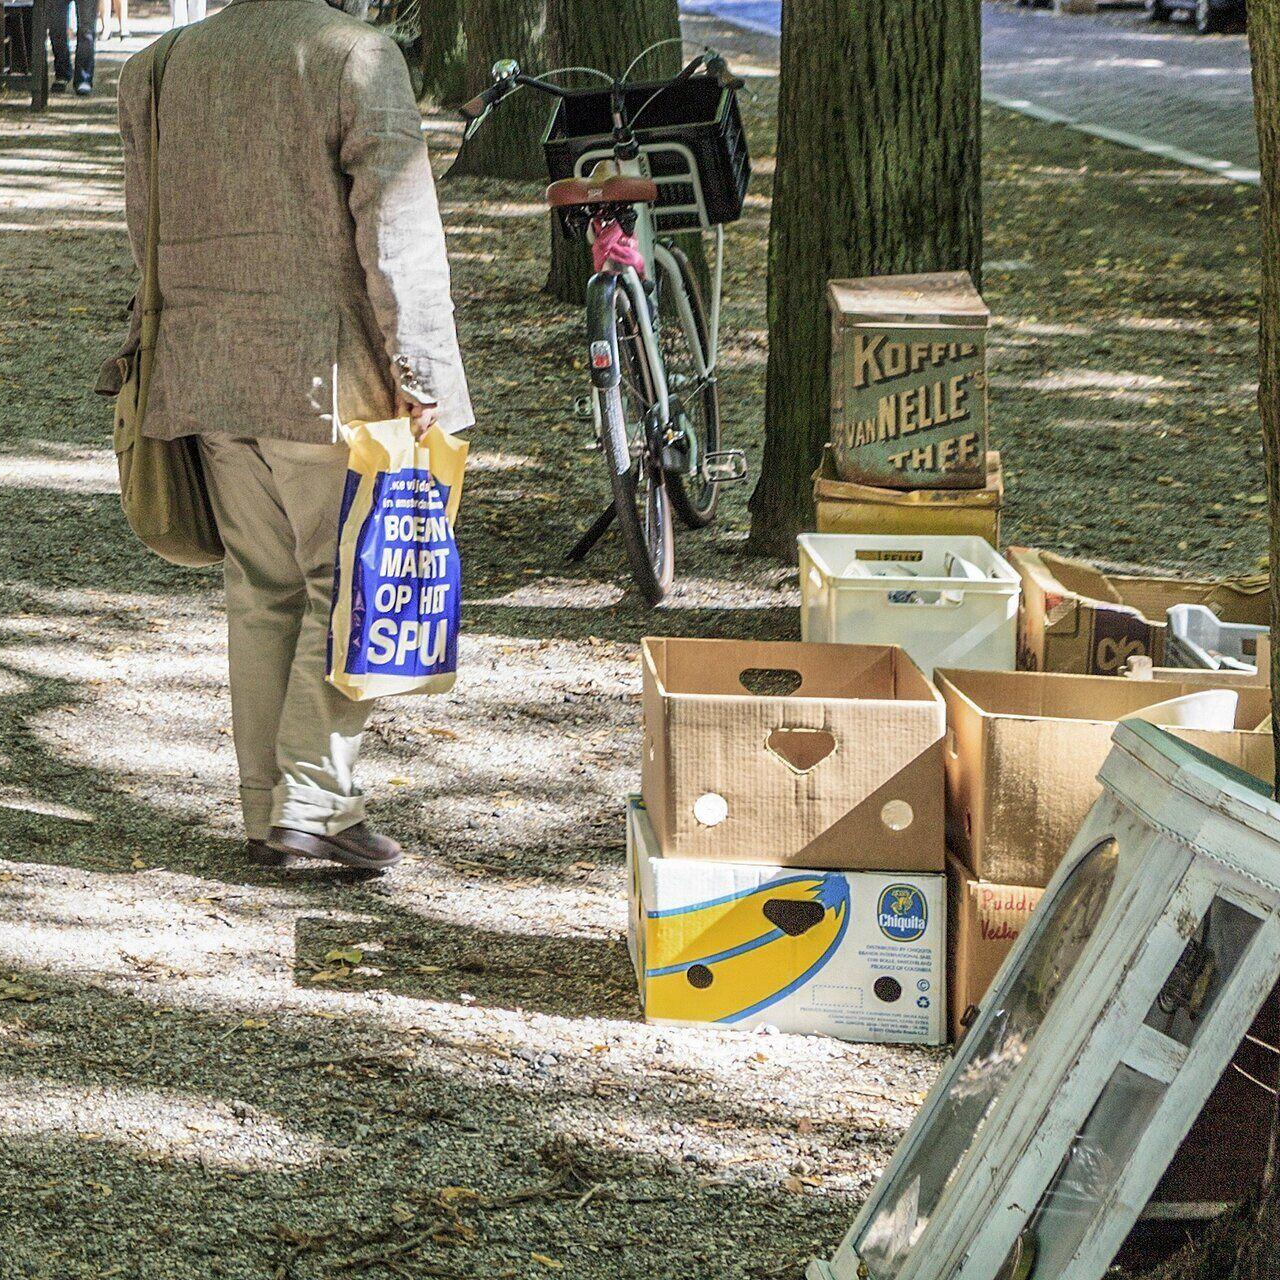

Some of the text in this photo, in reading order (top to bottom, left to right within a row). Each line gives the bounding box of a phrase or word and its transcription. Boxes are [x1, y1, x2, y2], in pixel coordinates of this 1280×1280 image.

[847, 418, 876, 449] VAN
[888, 431, 979, 470] THEE
[374, 583, 413, 614] OP
[366, 617, 448, 667] SPUI
[981, 888, 1037, 913] Puddi
[879, 913, 926, 932] Chiquita
